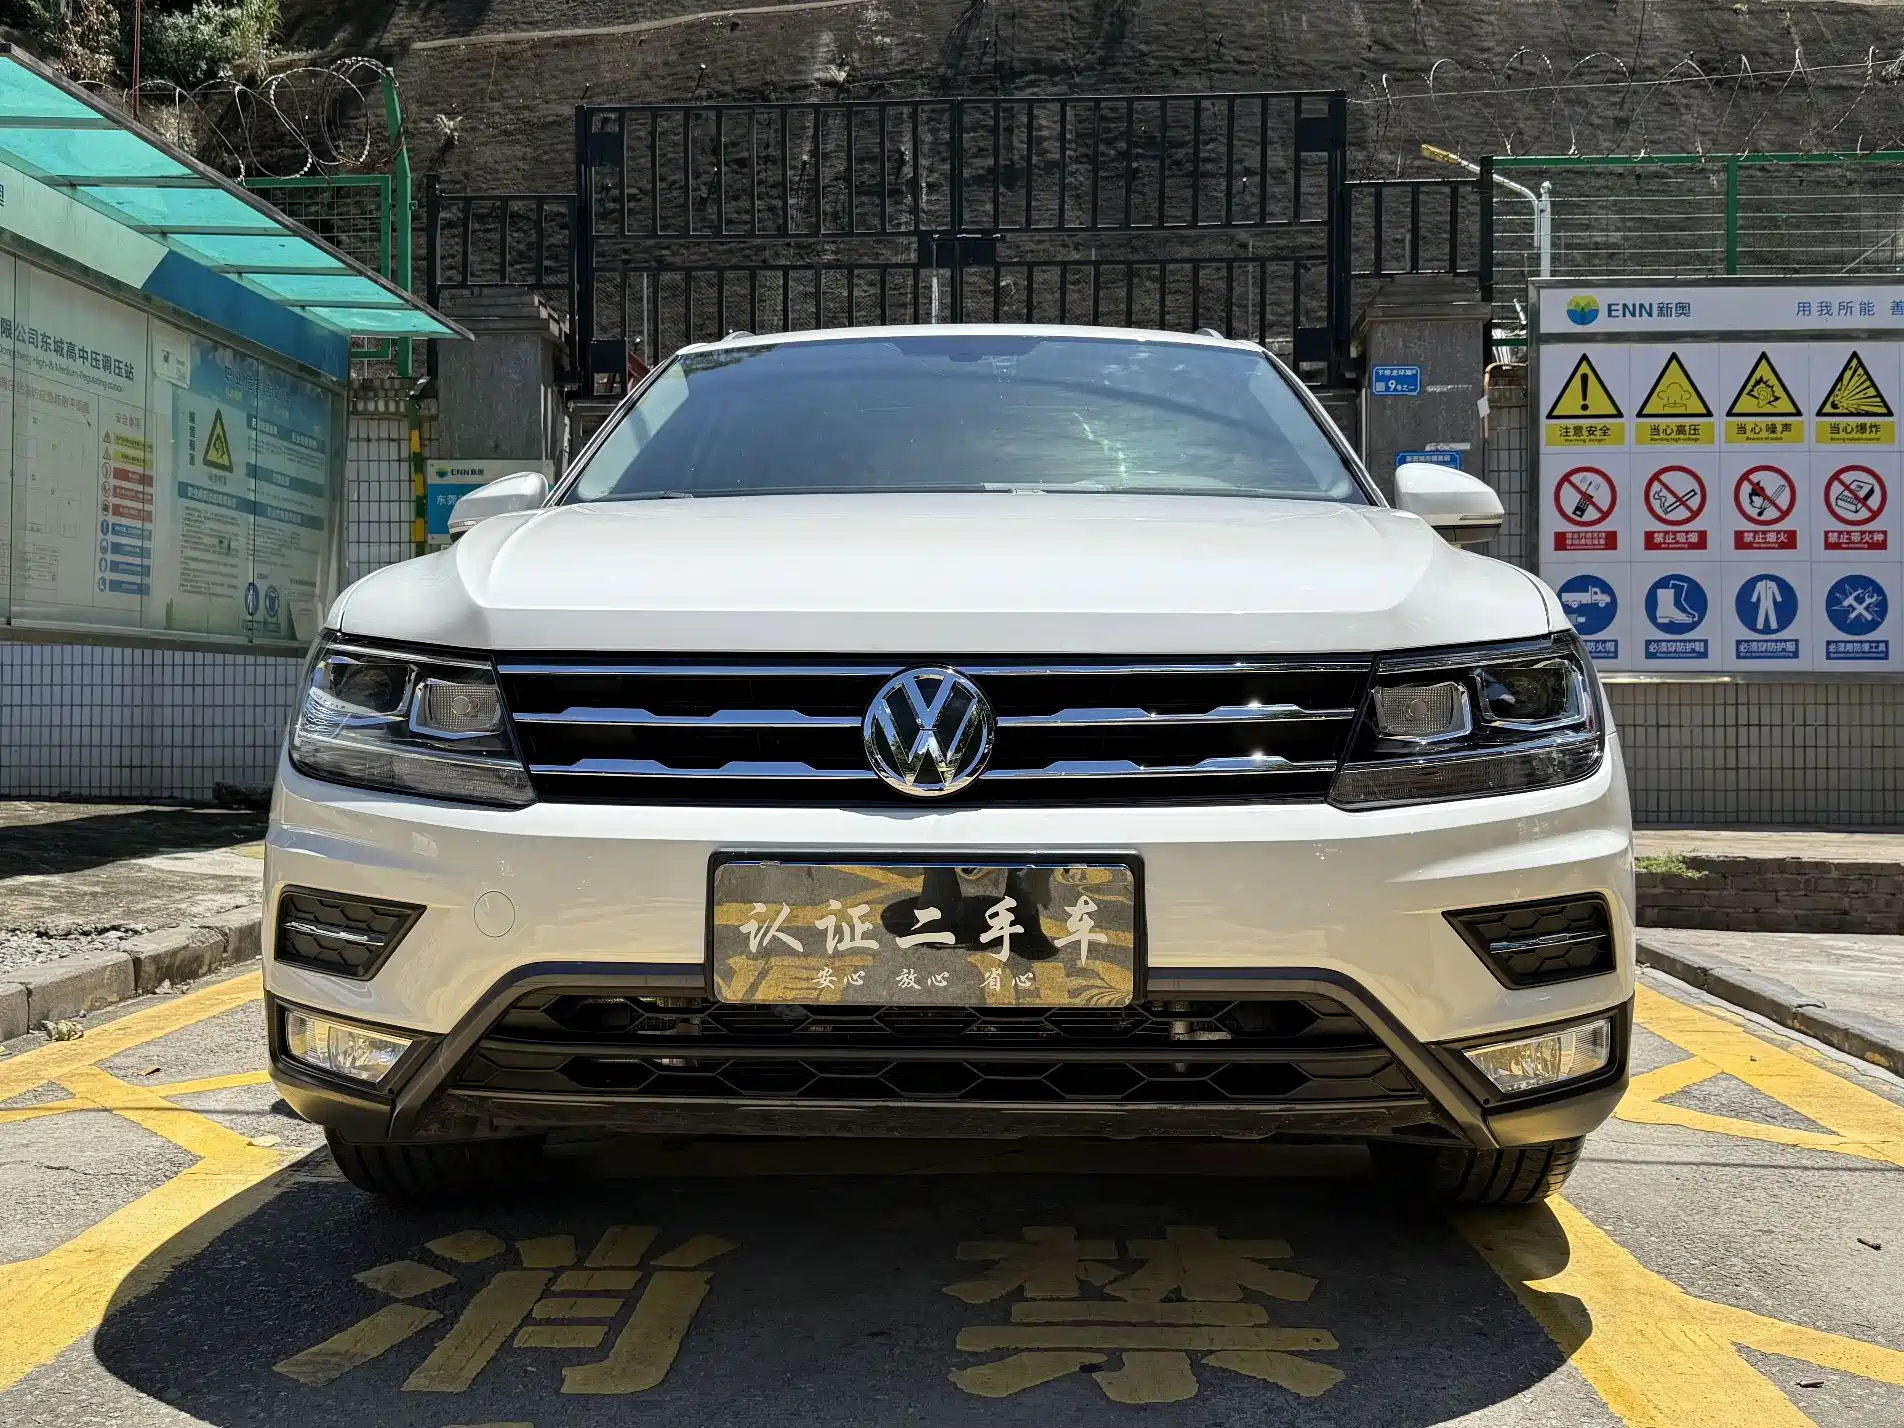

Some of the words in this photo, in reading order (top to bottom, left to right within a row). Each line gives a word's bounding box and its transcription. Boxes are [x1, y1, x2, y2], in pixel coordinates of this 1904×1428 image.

[1795, 299, 1876, 317] 用我所能
[1559, 425, 1611, 437] 注意安全
[1649, 424, 1701, 437] 当心高压
[1735, 423, 1793, 435] 当心噪声
[1829, 422, 1881, 435] 当心爆炸
[1653, 532, 1699, 543] 禁止吸烟
[1743, 532, 1788, 543] 禁止烟火
[1828, 532, 1885, 543] 禁止带火种
[739, 895, 1109, 966] 认证二手车
[812, 966, 865, 990] 安心
[895, 966, 950, 989] 放心
[979, 966, 1034, 991] 省心
[272, 1224, 738, 1395] 消
[940, 1225, 1348, 1404] 禁
